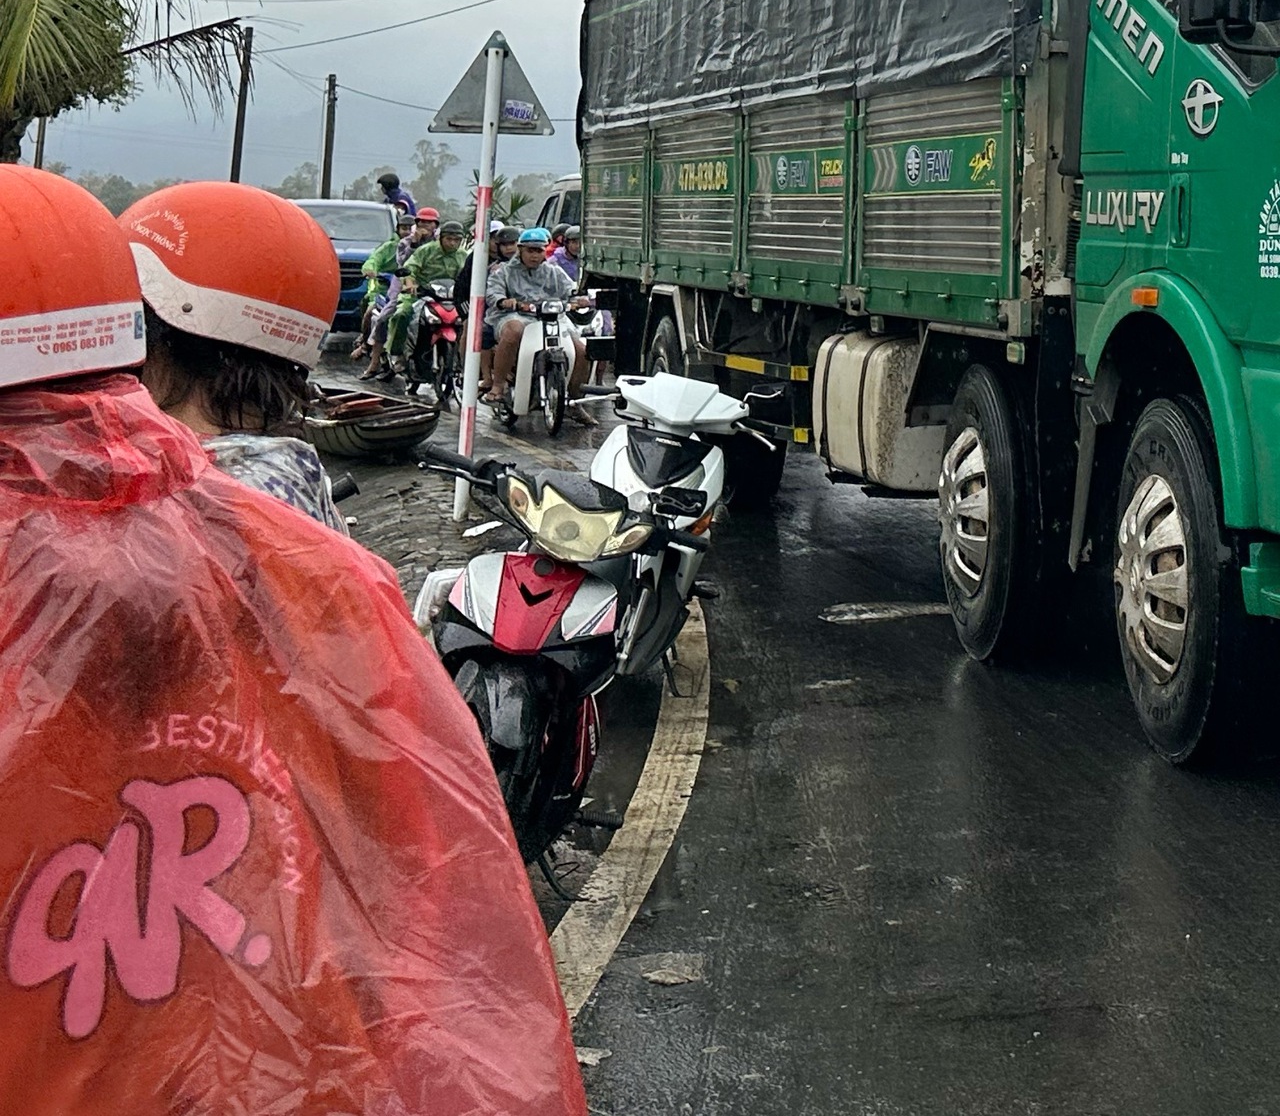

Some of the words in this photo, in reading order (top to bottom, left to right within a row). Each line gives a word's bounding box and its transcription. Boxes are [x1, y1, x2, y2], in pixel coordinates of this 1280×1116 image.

[790, 160, 810, 188] FAW
[820, 159, 844, 176] TRUCK
[925, 149, 953, 183] FAW
[1086, 190, 1164, 233] LUXURY
